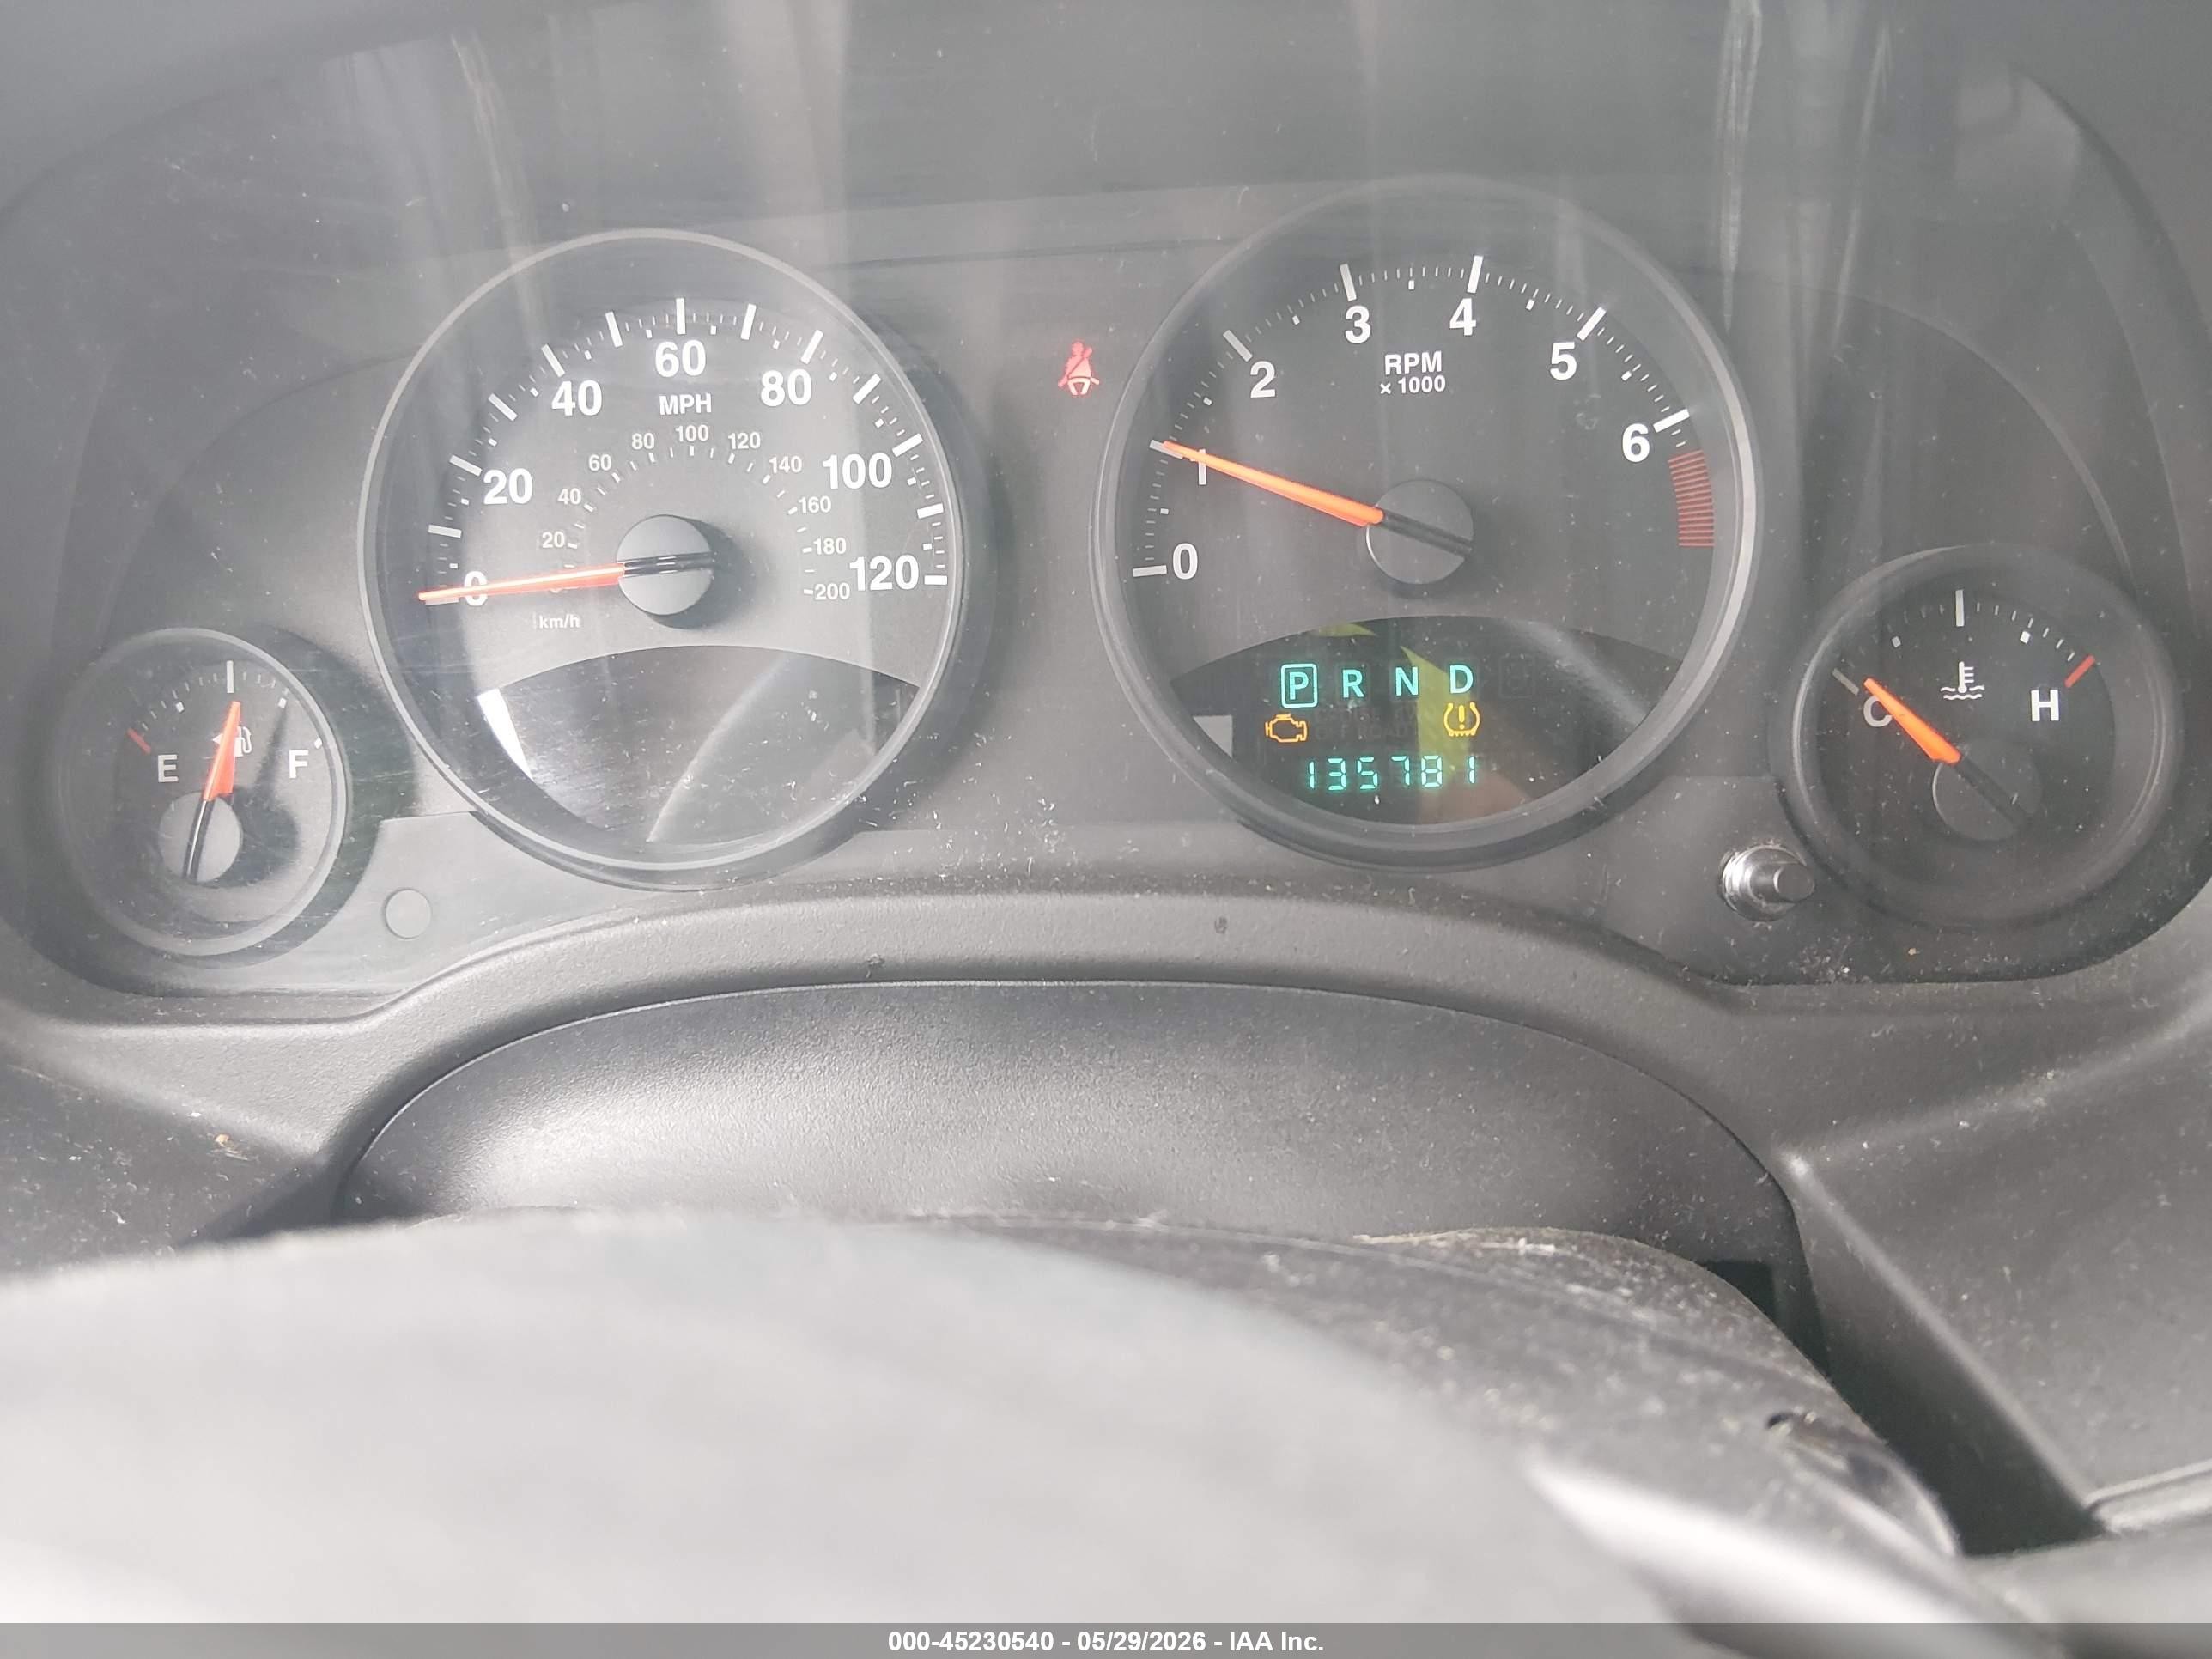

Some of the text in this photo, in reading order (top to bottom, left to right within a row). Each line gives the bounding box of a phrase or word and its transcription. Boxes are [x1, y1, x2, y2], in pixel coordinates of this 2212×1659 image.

[1345, 305, 1371, 343] 3
[1449, 297, 1477, 336] 4
[655, 341, 706, 378] 60
[1384, 350, 1442, 374] RPM
[1550, 341, 1577, 380] 5
[761, 368, 812, 407] 80
[1250, 361, 1276, 398] 2
[1397, 374, 1446, 395] 1000
[551, 379, 602, 416] 40
[659, 392, 712, 416] MPH
[631, 432, 655, 450] 80
[675, 424, 709, 442] 100
[727, 431, 761, 450] 120
[1622, 423, 1650, 463] 6
[588, 453, 612, 471] 60
[769, 455, 803, 474] 140
[823, 453, 892, 489] 100
[483, 468, 533, 505] 20
[557, 487, 582, 505] 40
[798, 495, 832, 514] 160
[542, 531, 566, 549] 20
[813, 537, 847, 556] 180
[849, 556, 919, 592] 120
[1172, 543, 1198, 580] 0
[465, 570, 488, 606] 0
[814, 582, 849, 600] 200
[538, 613, 580, 629] km/h
[1289, 672, 1310, 700] P
[1342, 669, 1364, 698] R
[1395, 665, 1420, 696] N
[1449, 665, 1474, 694] D
[1863, 695, 1893, 728] C
[2031, 689, 2059, 722] H
[157, 754, 179, 783] E
[289, 749, 309, 779] F
[1308, 755, 1476, 791] 135781
